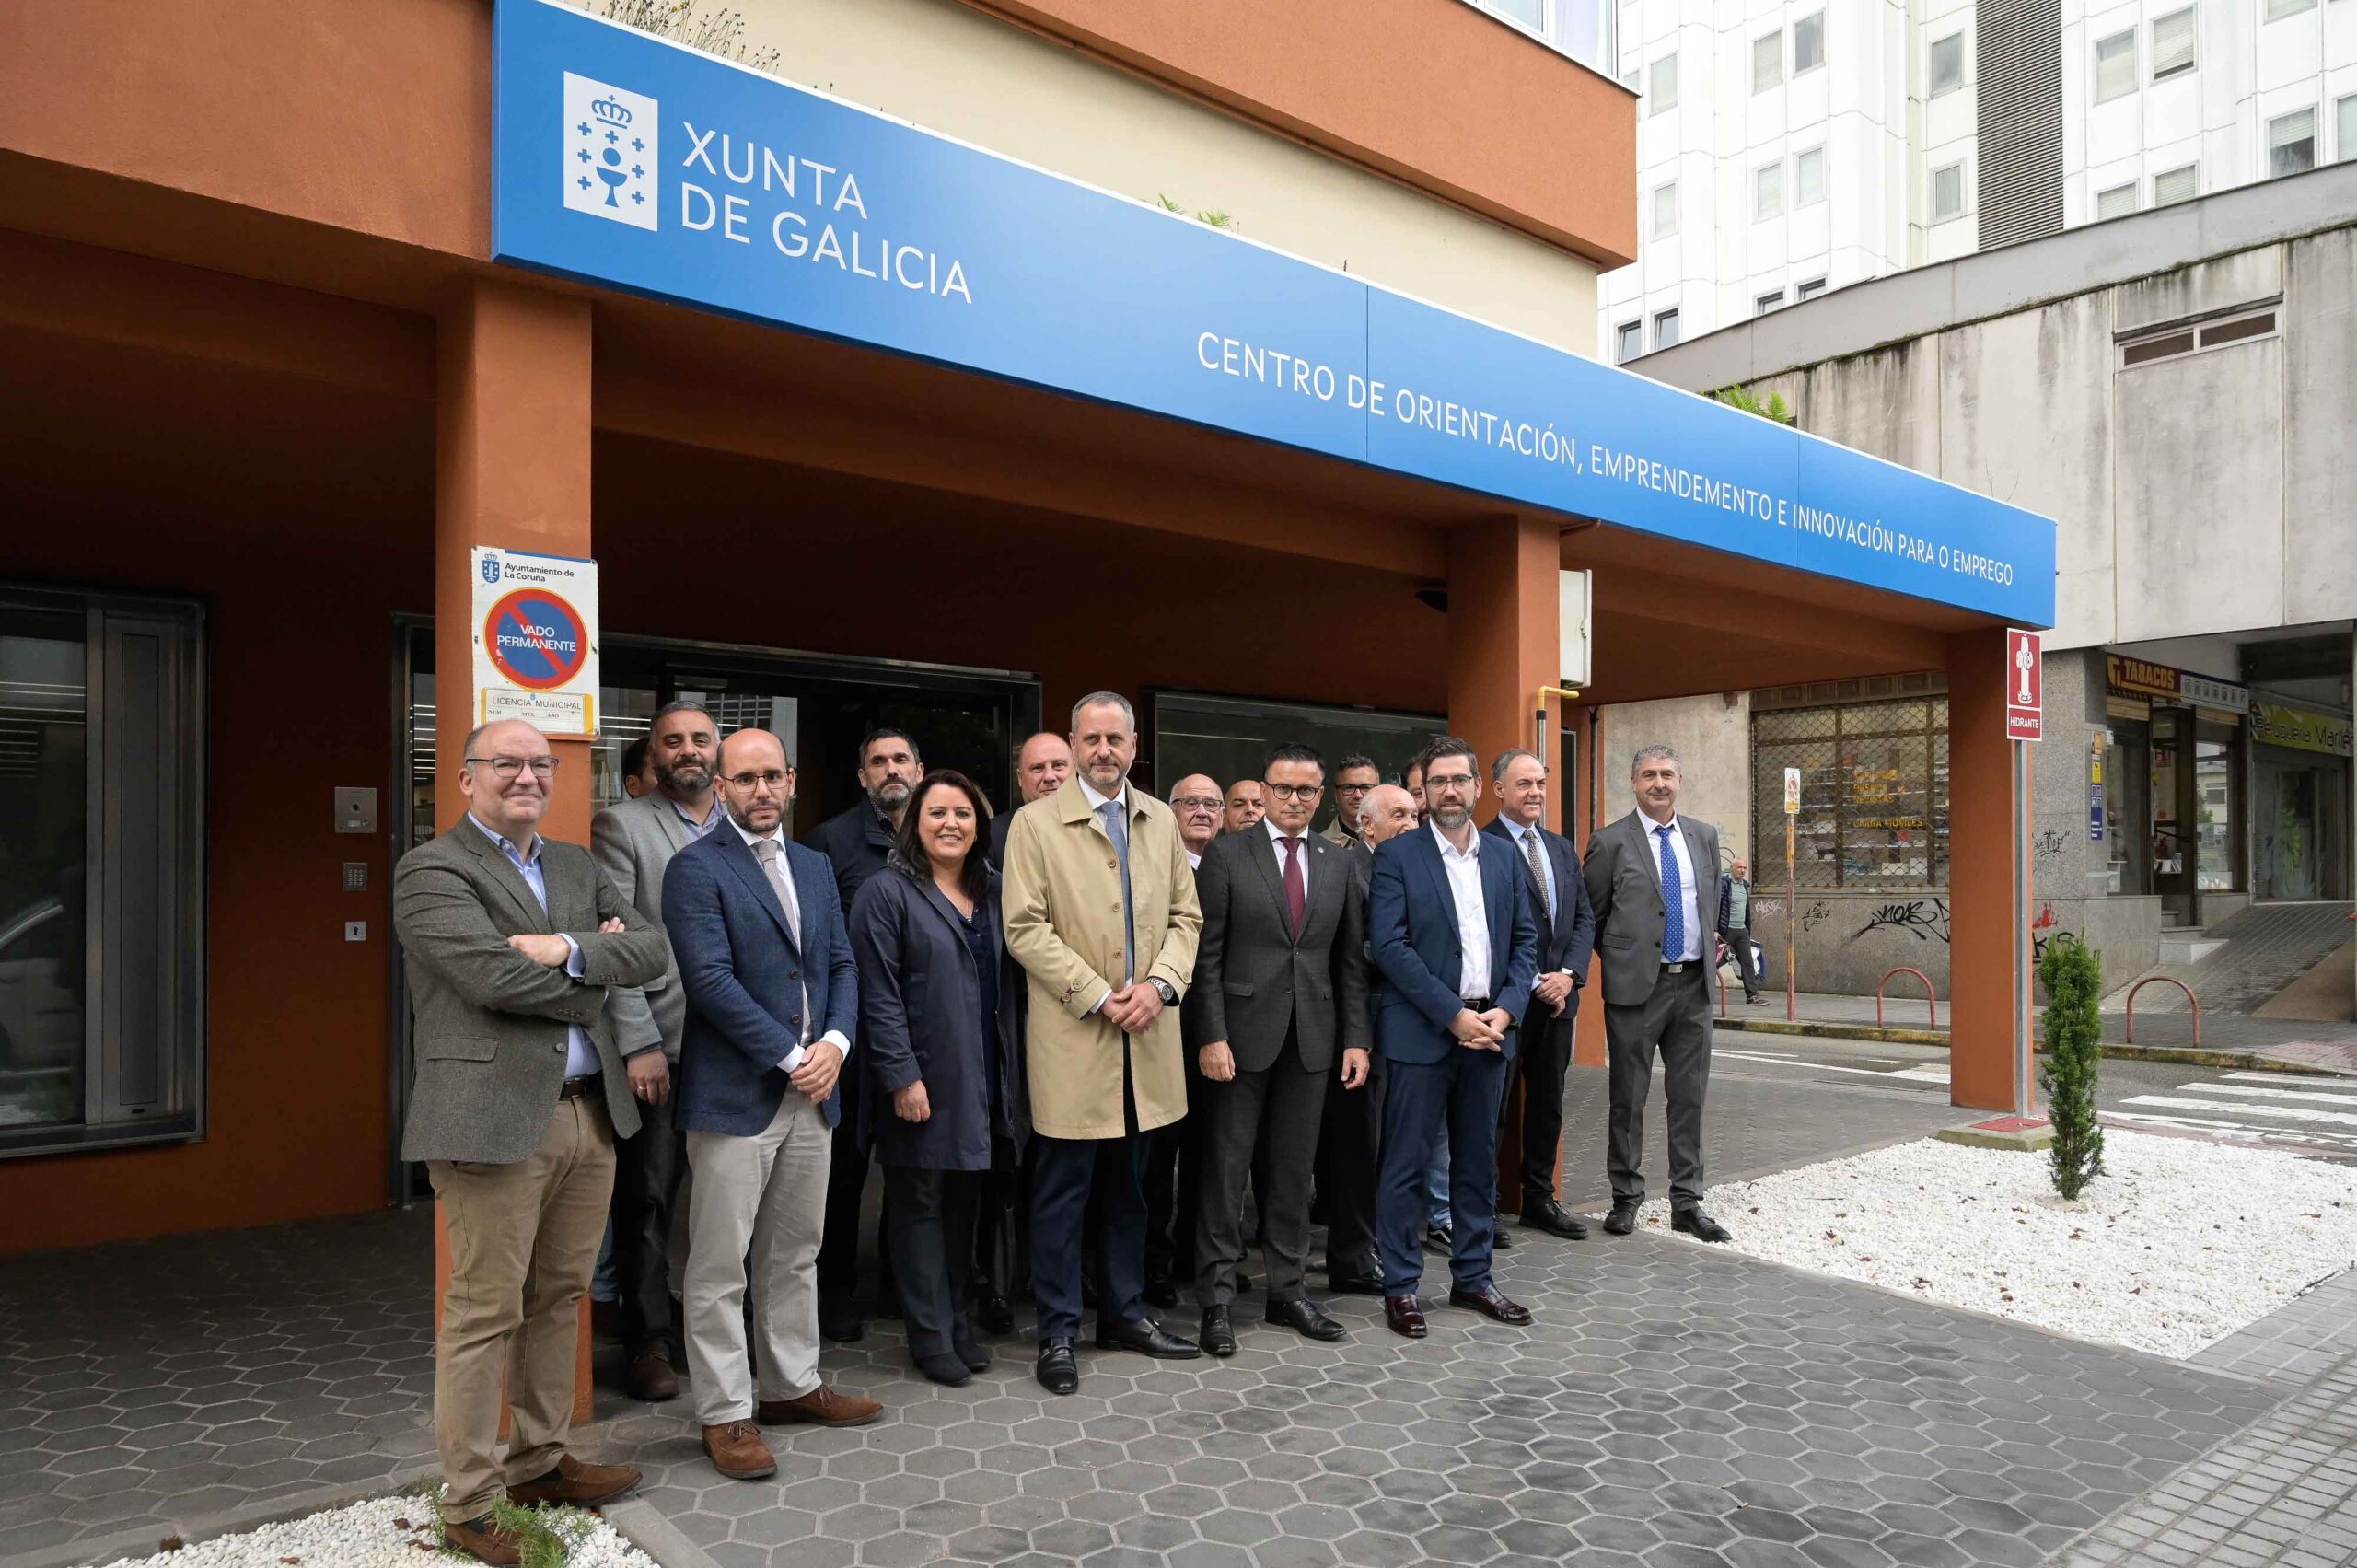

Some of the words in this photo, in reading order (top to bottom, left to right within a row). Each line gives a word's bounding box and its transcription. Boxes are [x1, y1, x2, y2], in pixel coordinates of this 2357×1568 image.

[682, 122, 867, 219] XUNTA
[682, 182, 750, 244] DE
[772, 212, 972, 304] GALICIA
[1198, 331, 1335, 401] CENTRO
[1348, 374, 1385, 416] DE
[1396, 389, 1583, 474] ORIENTACIÓN,
[1591, 445, 1771, 521] EMPRENDEMENTO
[1778, 498, 1787, 527] E
[1793, 503, 1893, 554] INNOVACIÓN
[1899, 532, 1934, 565] PARA
[1939, 545, 1949, 569] O
[1954, 550, 2014, 587] EMPREGO
[505, 563, 563, 576] Ayuntamiento
[505, 571, 515, 579] La
[516, 572, 546, 582] Coruña
[520, 624, 555, 638] VADO
[497, 634, 576, 652] PERMANENTE
[2124, 660, 2175, 690] TABACOS
[492, 697, 532, 707] LICENCIA
[535, 700, 582, 710] MUNICIPAL
[2010, 716, 2039, 729] HIDRANTE
